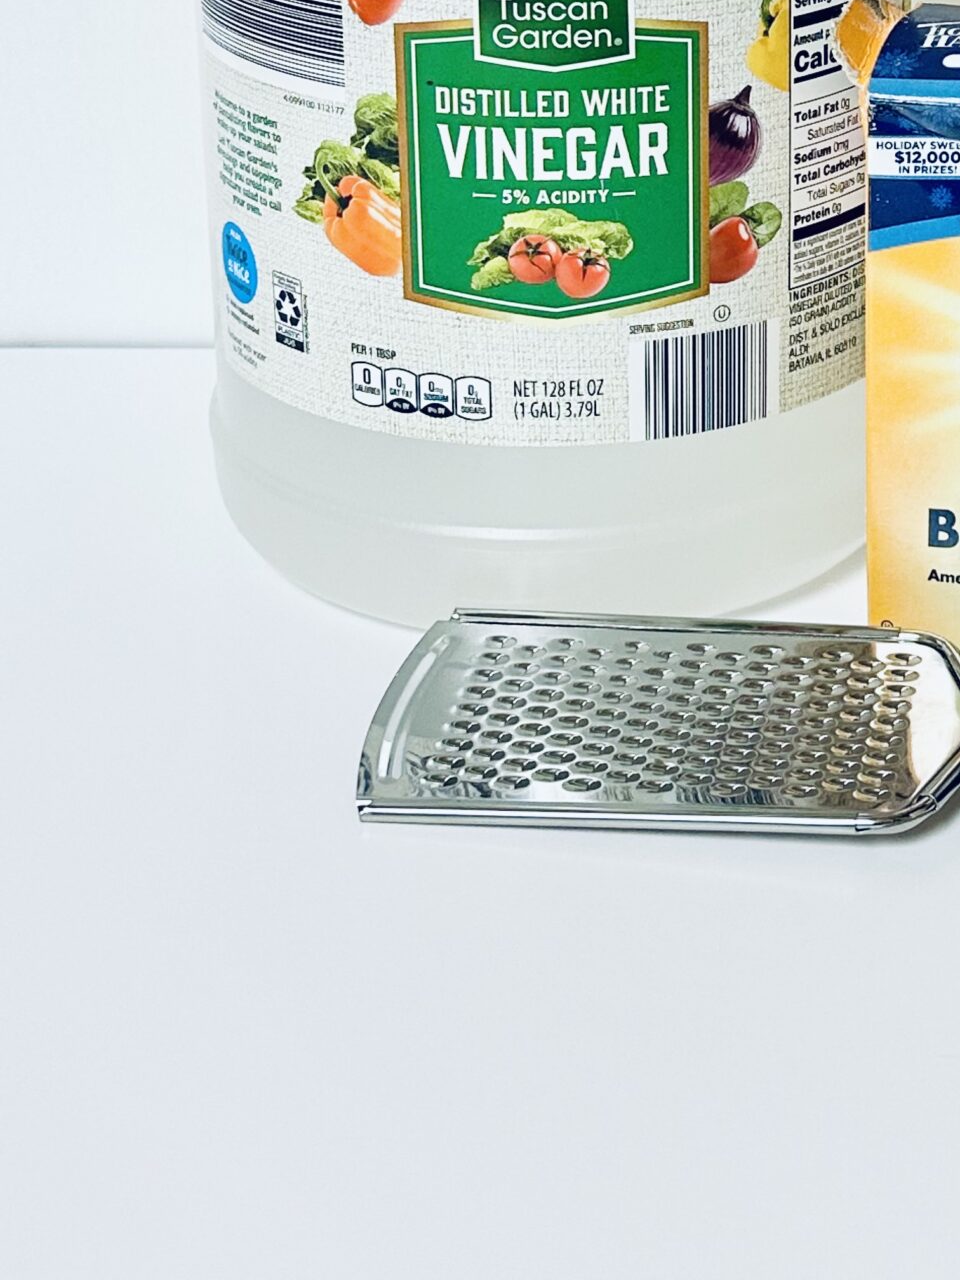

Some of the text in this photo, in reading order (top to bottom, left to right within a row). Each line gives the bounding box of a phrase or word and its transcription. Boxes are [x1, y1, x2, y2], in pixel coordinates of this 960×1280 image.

[793, 29, 824, 47] Amount
[435, 84, 670, 118] DISTILLED WHITE
[794, 98, 851, 123] Total Fat 0g
[807, 113, 859, 141] Saturated Fat
[436, 122, 669, 181] VINEGAR
[794, 139, 849, 165] Sodium 0mg
[876, 140, 927, 150] HOLIDAY
[794, 150, 866, 185] Total Carbohyd
[898, 165, 958, 175] IN PRIZES!
[501, 189, 609, 205] 5% ACIDITY
[807, 185, 828, 202] Total
[829, 176, 856, 195] Sugars
[794, 206, 831, 227] Protein
[789, 276, 866, 315] VINEGAR DILUTED WIT
[629, 318, 695, 335] SERVING SUGGESTION
[820, 318, 840, 336] SOLD
[841, 305, 866, 326] EXCLUS
[351, 343, 367, 356] PER
[376, 348, 397, 360] TBSP
[363, 368, 371, 384] 0
[513, 378, 605, 398] NET 128 FL OZ
[513, 400, 601, 420] (1 GAL) 3.79L
